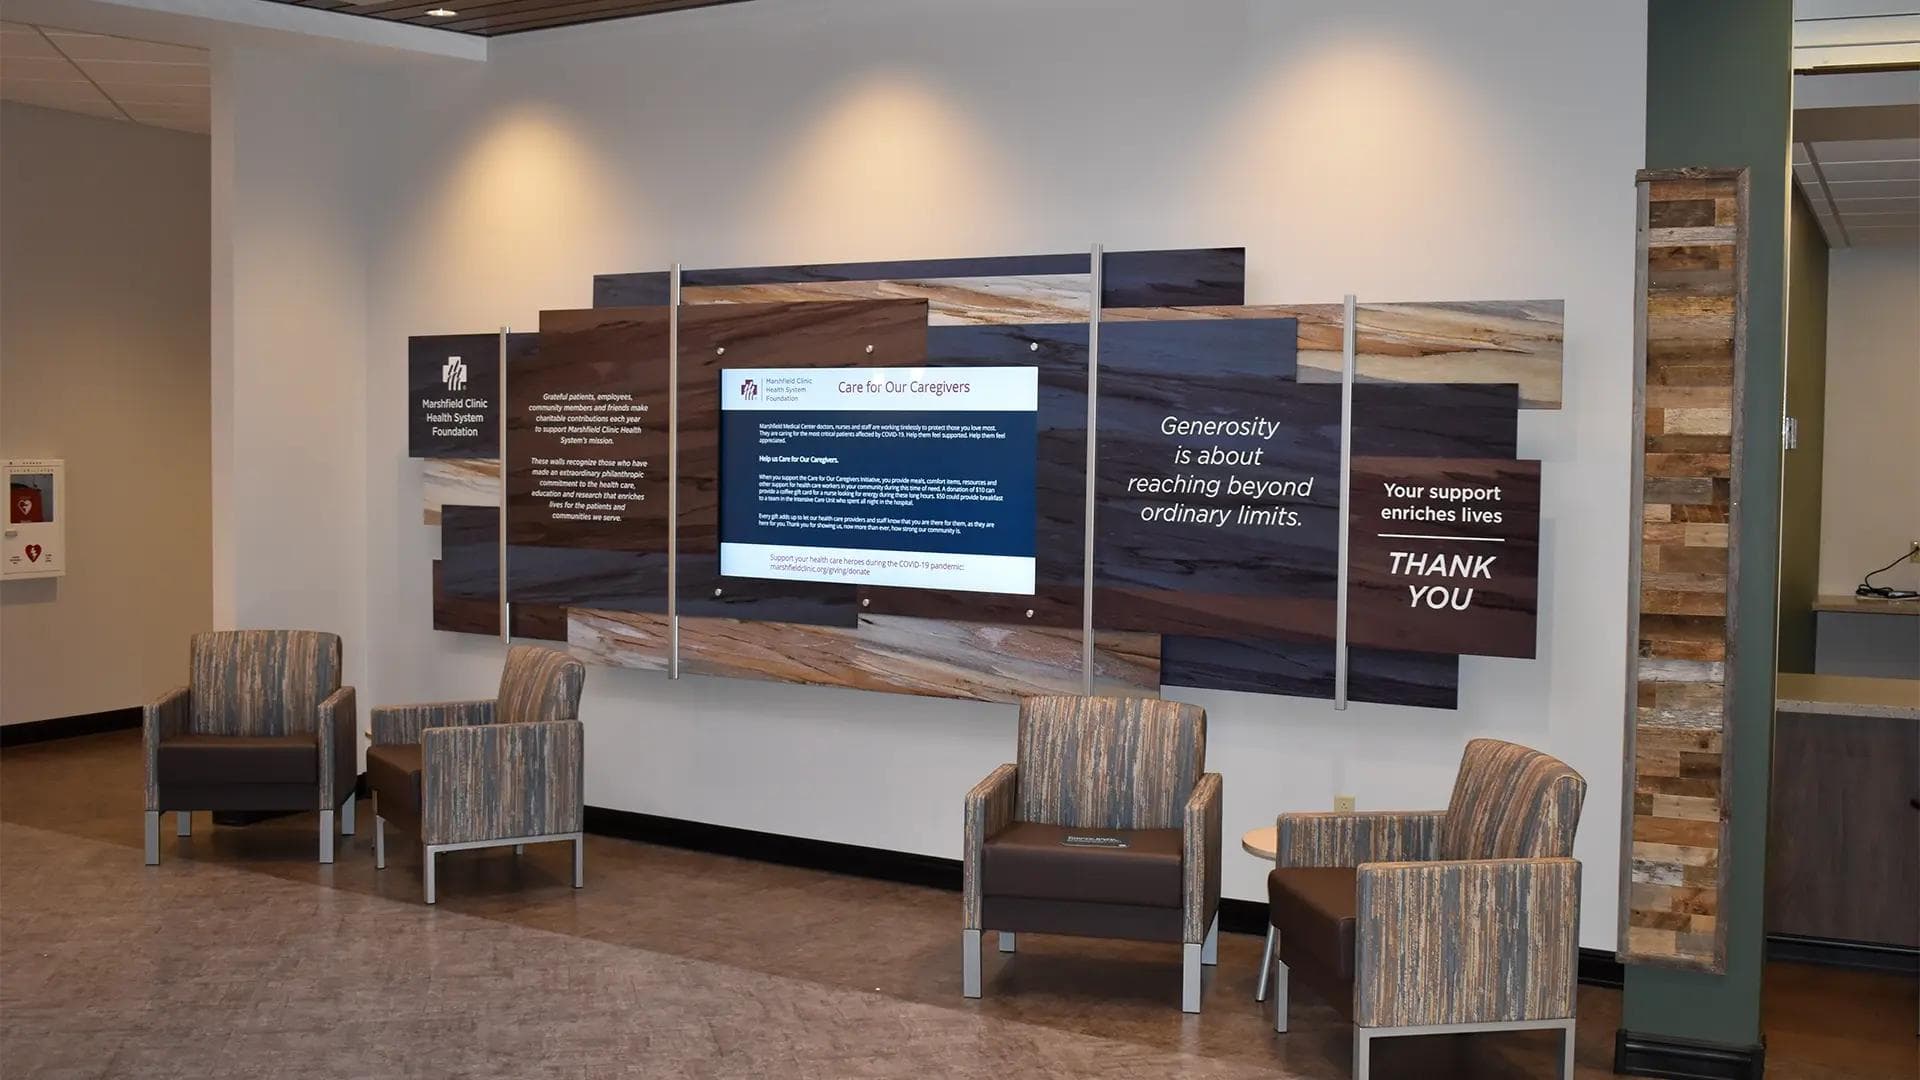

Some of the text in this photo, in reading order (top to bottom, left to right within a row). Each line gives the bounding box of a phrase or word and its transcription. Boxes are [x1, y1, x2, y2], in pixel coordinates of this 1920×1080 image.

[838, 381, 970, 396] Care for Our Caregivers
[422, 399, 488, 408] Marshfield Clinic
[426, 412, 483, 424] Health System
[432, 427, 478, 436] Foundation
[1161, 416, 1280, 440] Generosity
[1174, 446, 1264, 466] is about
[601, 471, 644, 479] philanthropic
[1128, 474, 1314, 499] reaching beyond
[1384, 483, 1501, 503] Your support
[1141, 504, 1302, 527] ordinary limits.
[1381, 507, 1502, 524] enriches lives
[770, 554, 795, 565] Support
[795, 557, 807, 565] your
[810, 556, 828, 564] health
[844, 558, 864, 566] heroes
[866, 558, 886, 569] during
[899, 560, 929, 568] COVID-19
[931, 561, 964, 572] pandemic:
[770, 564, 870, 576] marshfieldclinic.org/giving/donate
[1389, 552, 1496, 579] THANK
[1408, 584, 1473, 611] YOU
